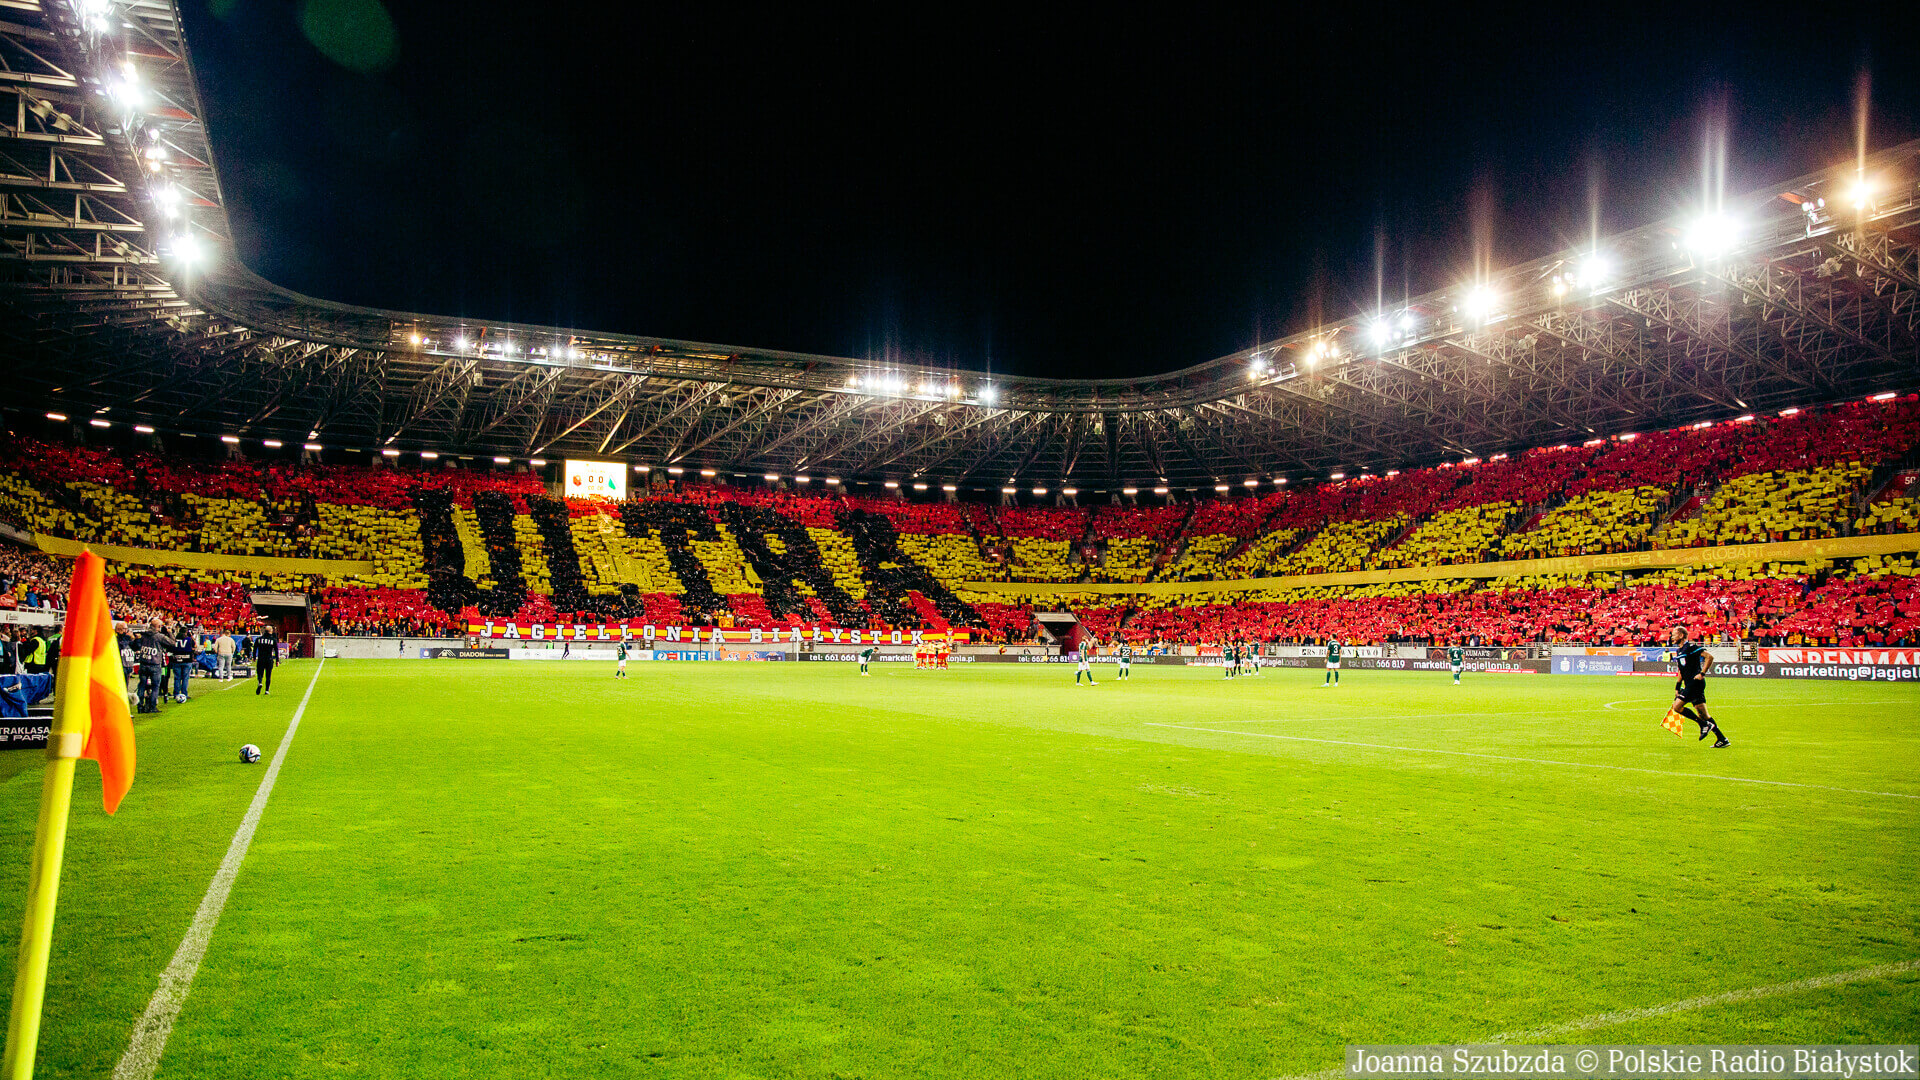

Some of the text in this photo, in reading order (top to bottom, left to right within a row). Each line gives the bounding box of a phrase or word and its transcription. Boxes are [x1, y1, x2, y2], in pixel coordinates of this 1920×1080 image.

[1702, 546, 1765, 560] GLOBART
[480, 621, 926, 645] JAGIELLONIA BIAŁYSTOK
[1122, 649, 1131, 657] 22
[1333, 645, 1339, 653] 3
[1453, 651, 1459, 659] 4
[1376, 660, 1391, 668] 666
[1391, 660, 1406, 668] 819
[1714, 664, 1736, 675] 666
[1741, 664, 1765, 675] 819
